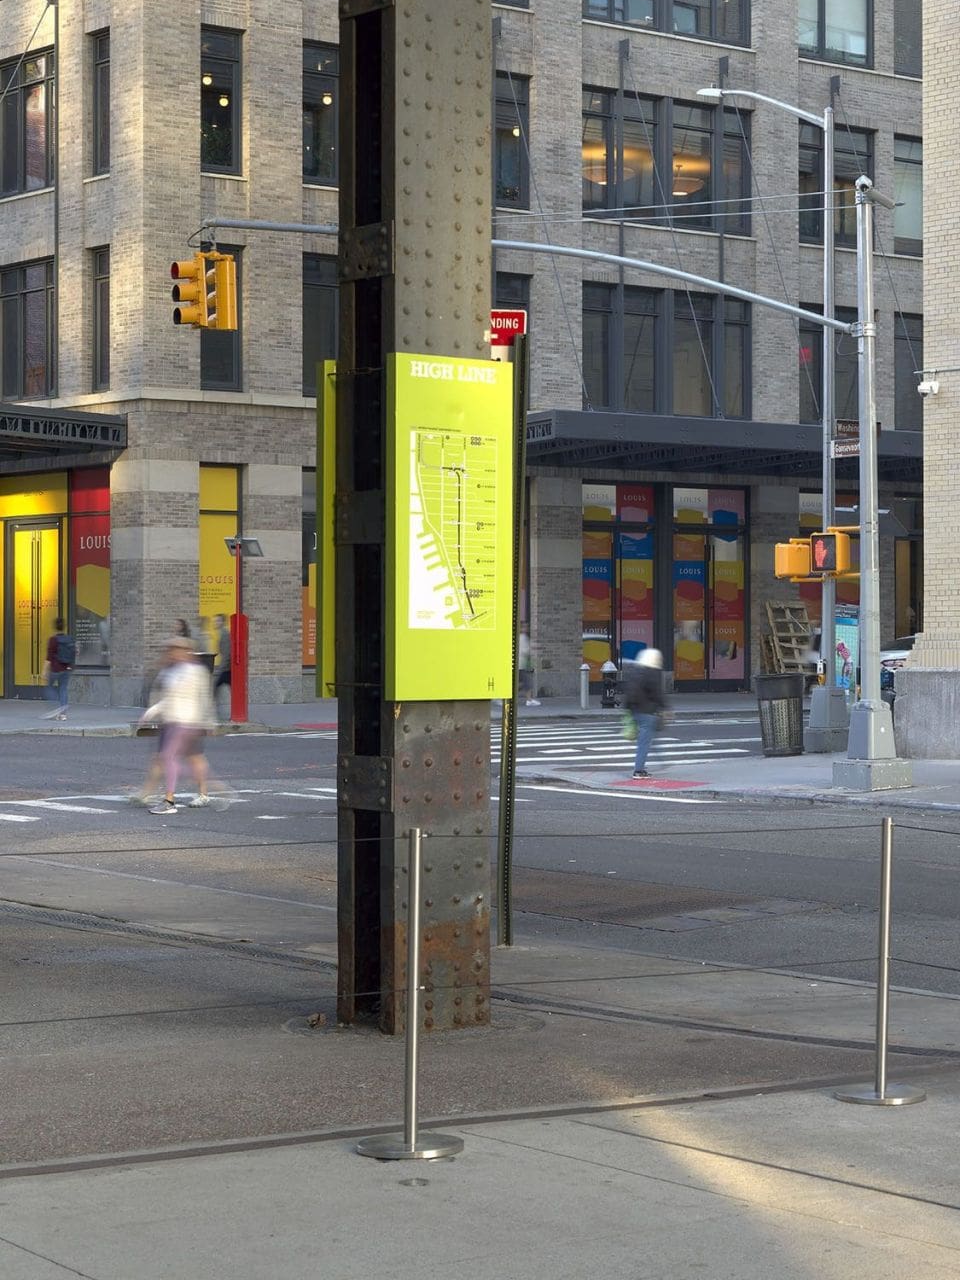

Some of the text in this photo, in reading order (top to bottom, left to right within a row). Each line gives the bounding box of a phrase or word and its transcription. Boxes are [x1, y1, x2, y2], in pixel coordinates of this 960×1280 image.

[490, 317, 520, 329] NDING
[409, 360, 498, 385] HIGH LINE
[623, 494, 647, 503] LOUIS
[584, 565, 609, 575] LOUIS
[679, 567, 702, 576] LOUIS
[714, 626, 738, 635] LOUIS
